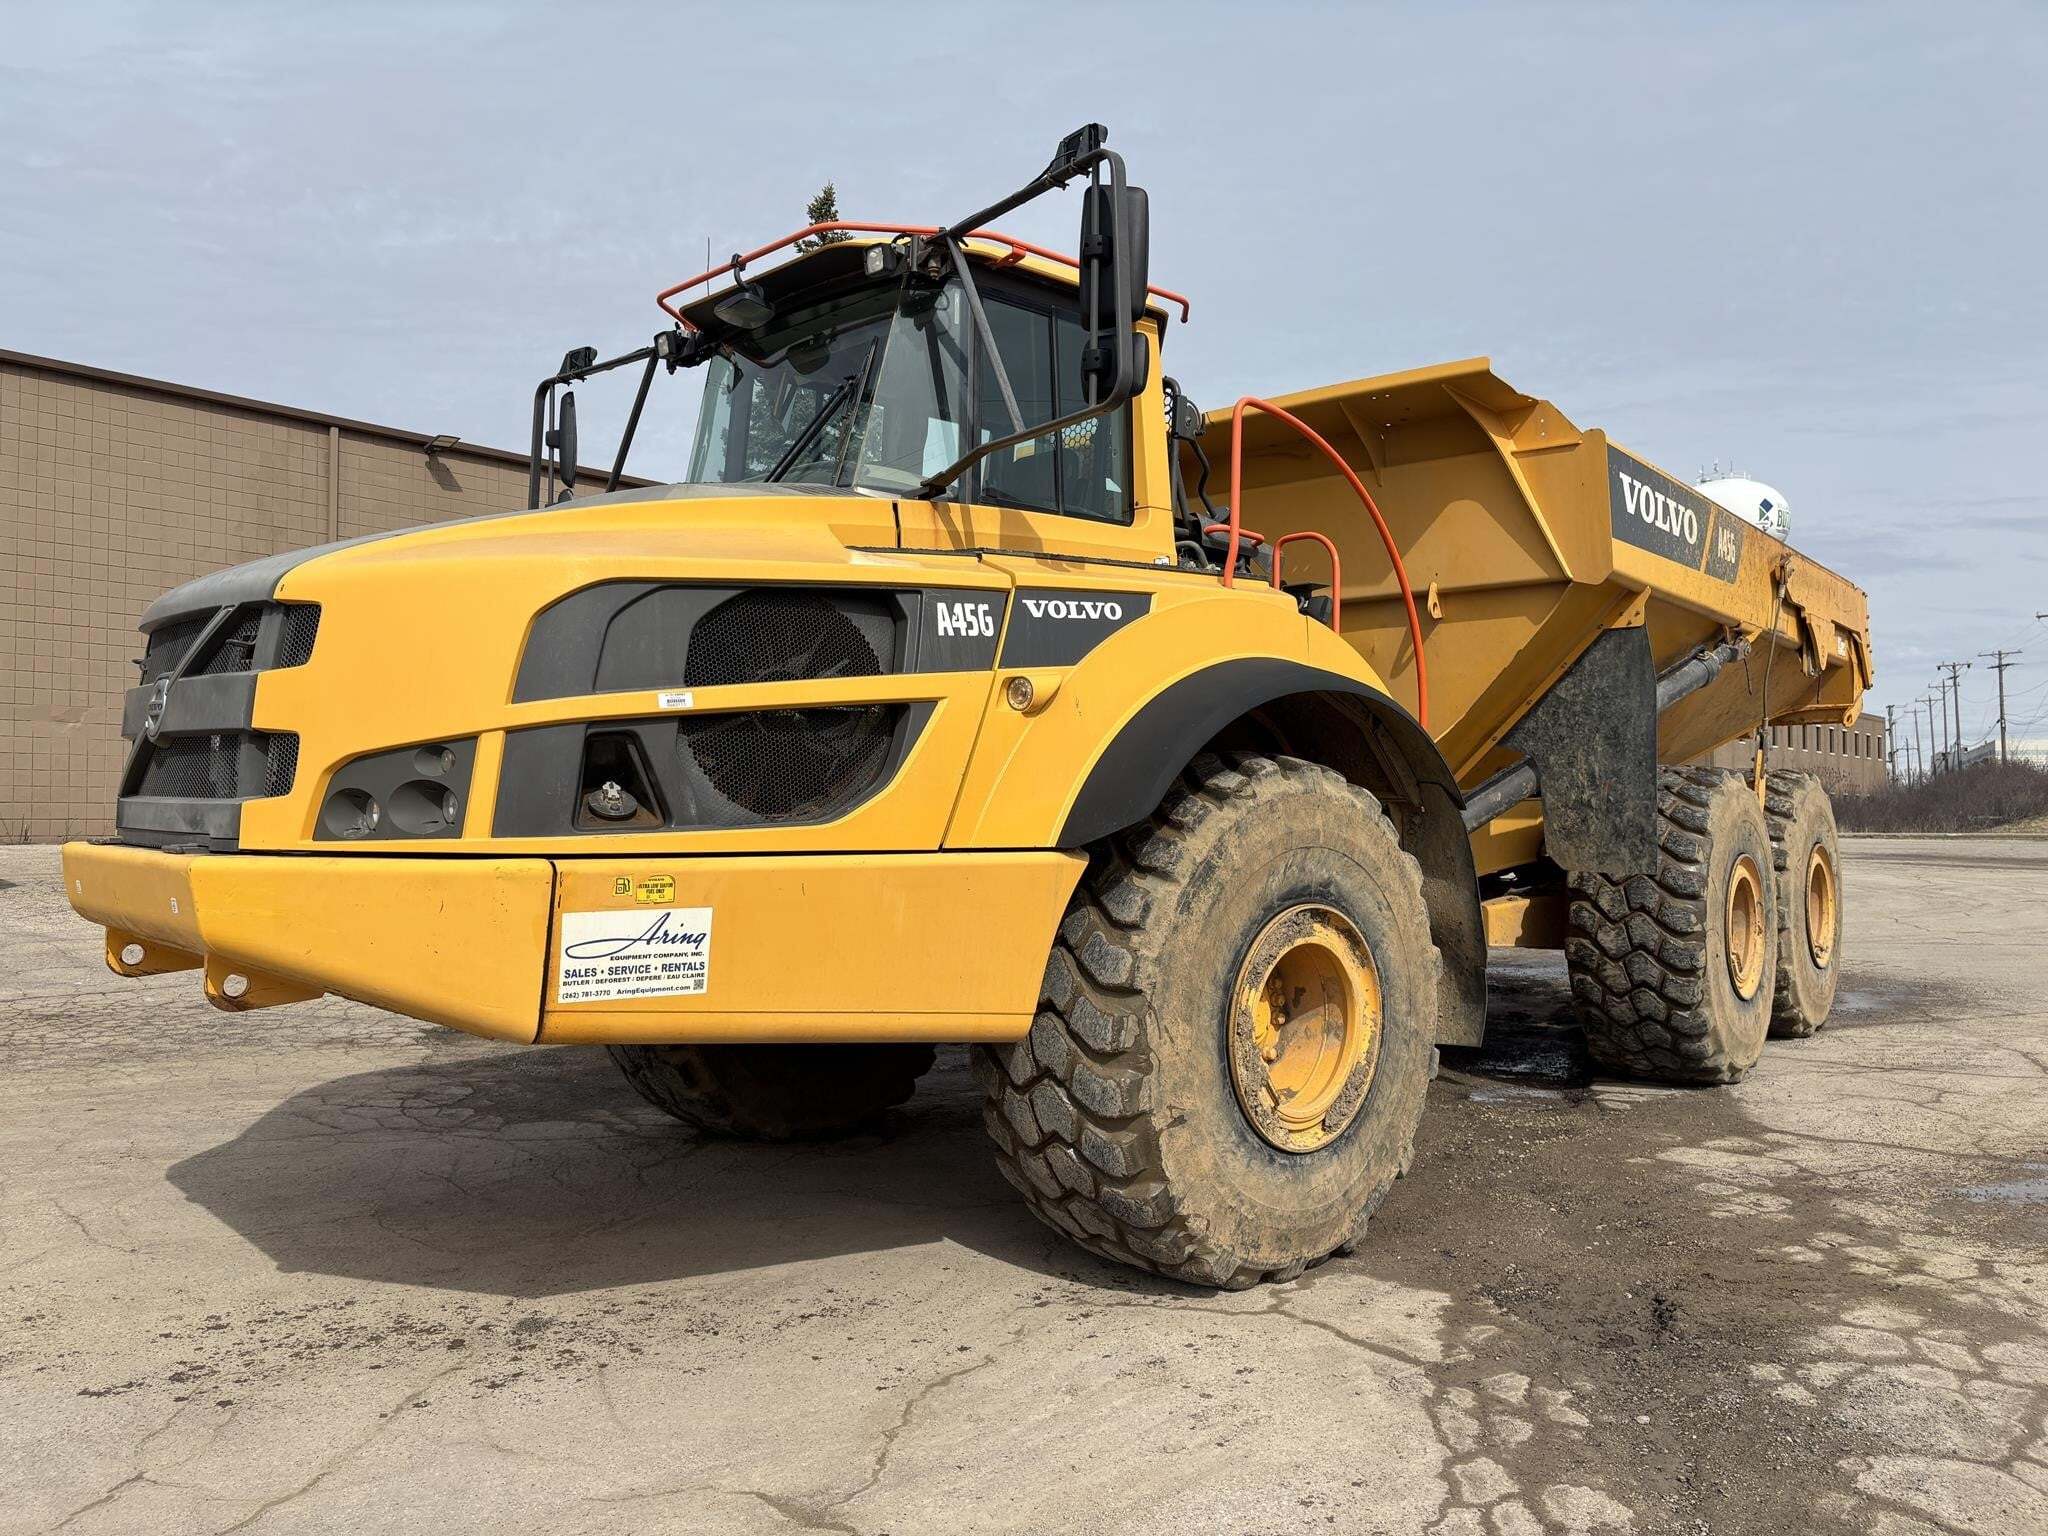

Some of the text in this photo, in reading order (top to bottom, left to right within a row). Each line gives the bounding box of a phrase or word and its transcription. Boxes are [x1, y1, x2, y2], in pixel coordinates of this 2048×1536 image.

[1619, 472, 1698, 545] VOLVO
[936, 602, 995, 637] A45G
[1022, 599, 1123, 621] VOLVO
[565, 912, 707, 960] Aring
[564, 961, 705, 979] SALES SERVICE RENTALS
